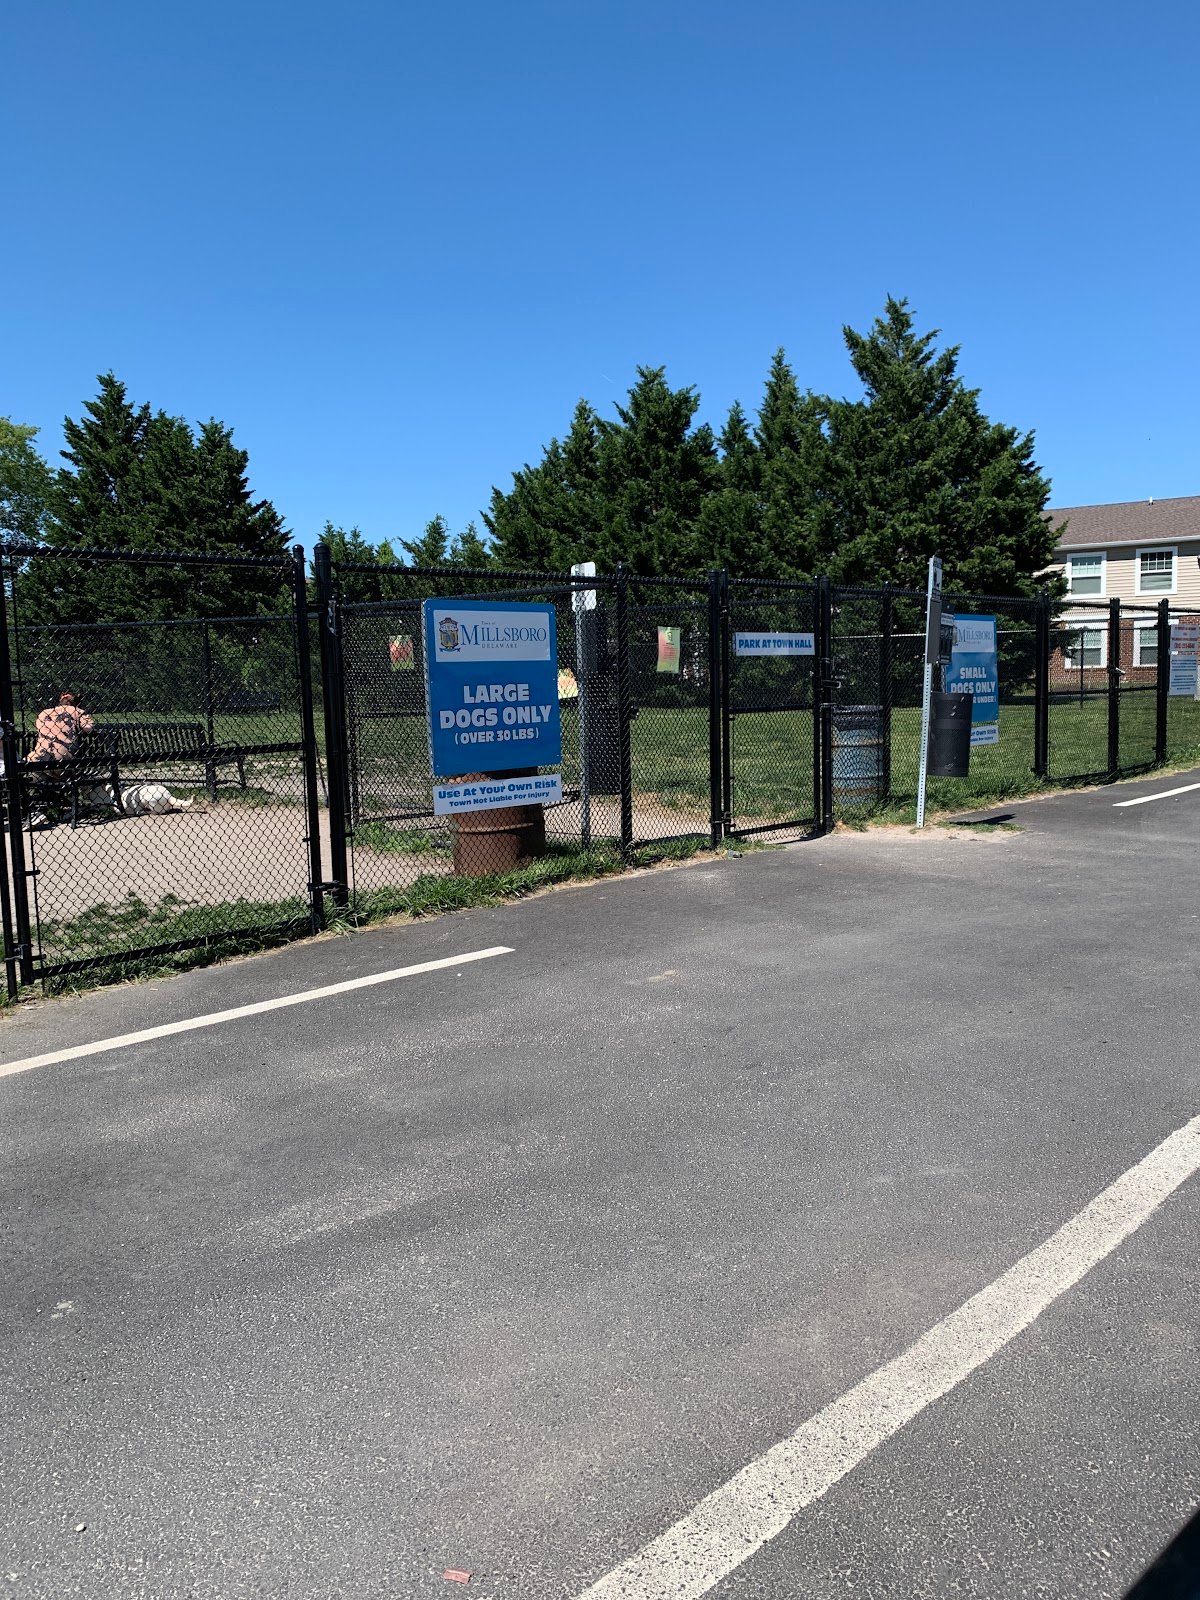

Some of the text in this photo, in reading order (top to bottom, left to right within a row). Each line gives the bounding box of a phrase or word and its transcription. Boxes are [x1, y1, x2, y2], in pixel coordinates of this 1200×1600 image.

[460, 624, 547, 646] MILLSBORO
[957, 628, 993, 642] MILLSBORO
[738, 639, 812, 649] PARK AT TOWN HALL
[960, 667, 987, 680] SMALL
[463, 683, 530, 704] LARGE
[950, 681, 996, 694] DOGS ONLY
[439, 704, 552, 729] DOGS ONLY
[454, 726, 540, 745] (OVER 30 LBS)
[438, 779, 557, 799] Use At Your Own Risk
[473, 797, 488, 805] Not
[489, 795, 512, 803] Liable
